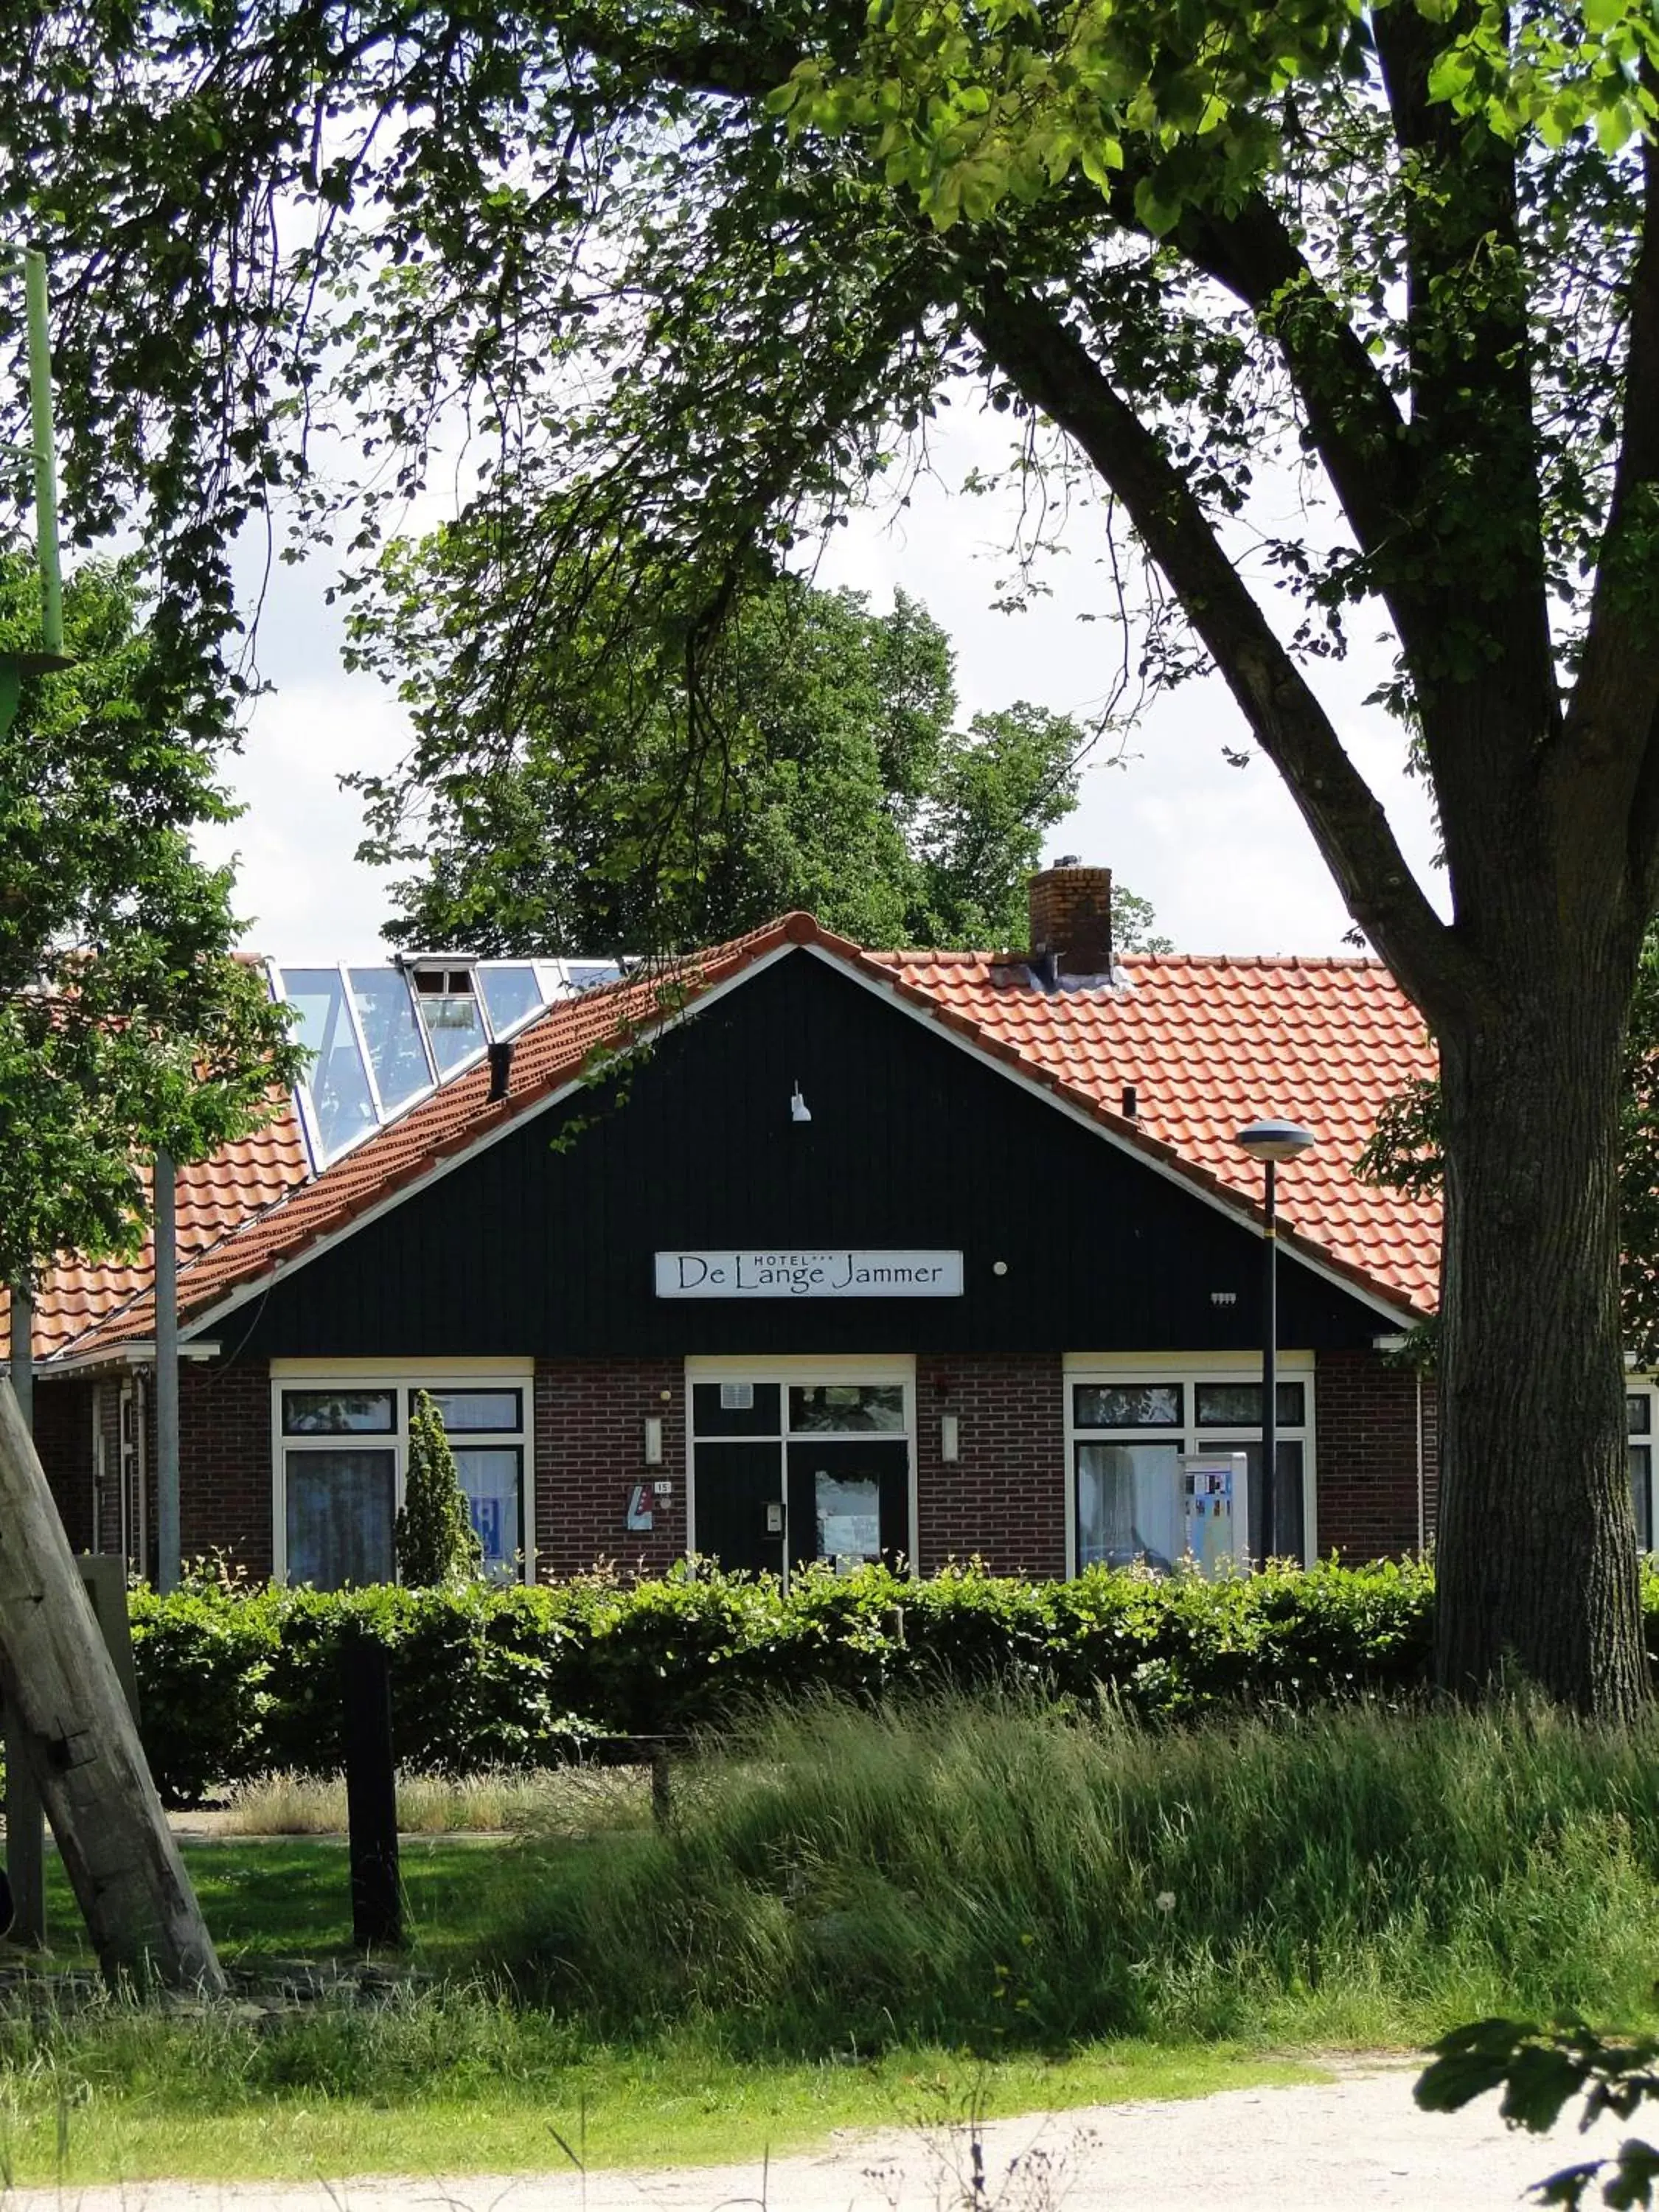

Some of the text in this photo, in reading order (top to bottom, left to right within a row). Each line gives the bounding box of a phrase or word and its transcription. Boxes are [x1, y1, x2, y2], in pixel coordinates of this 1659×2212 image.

[678, 1253, 943, 1294] De Lange Jammer
[658, 1482, 670, 1492] 15
